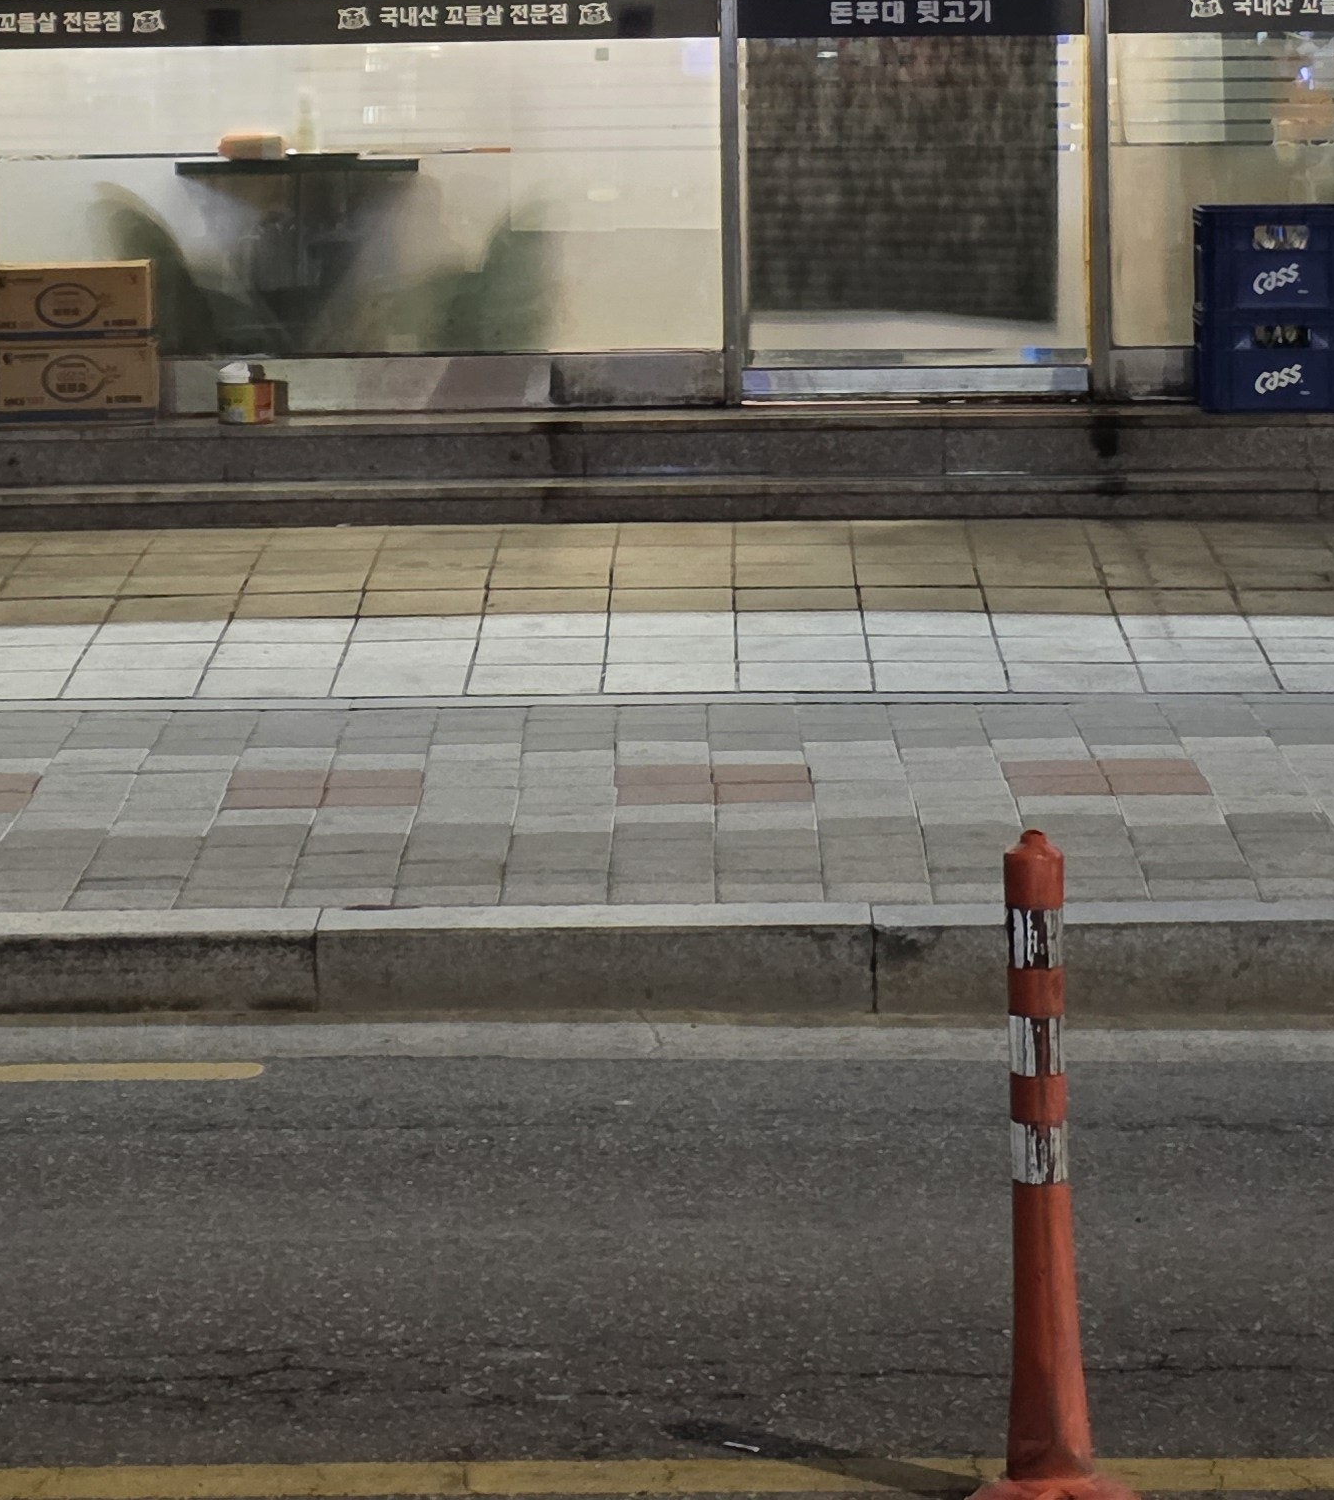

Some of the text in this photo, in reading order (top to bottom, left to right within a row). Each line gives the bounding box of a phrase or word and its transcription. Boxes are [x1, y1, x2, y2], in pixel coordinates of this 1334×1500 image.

[63, 10, 122, 32] 전문점
[379, 3, 567, 28] 국내산 꼬들살 전문점
[830, 0, 991, 25] 돈푸대 뒷고기
